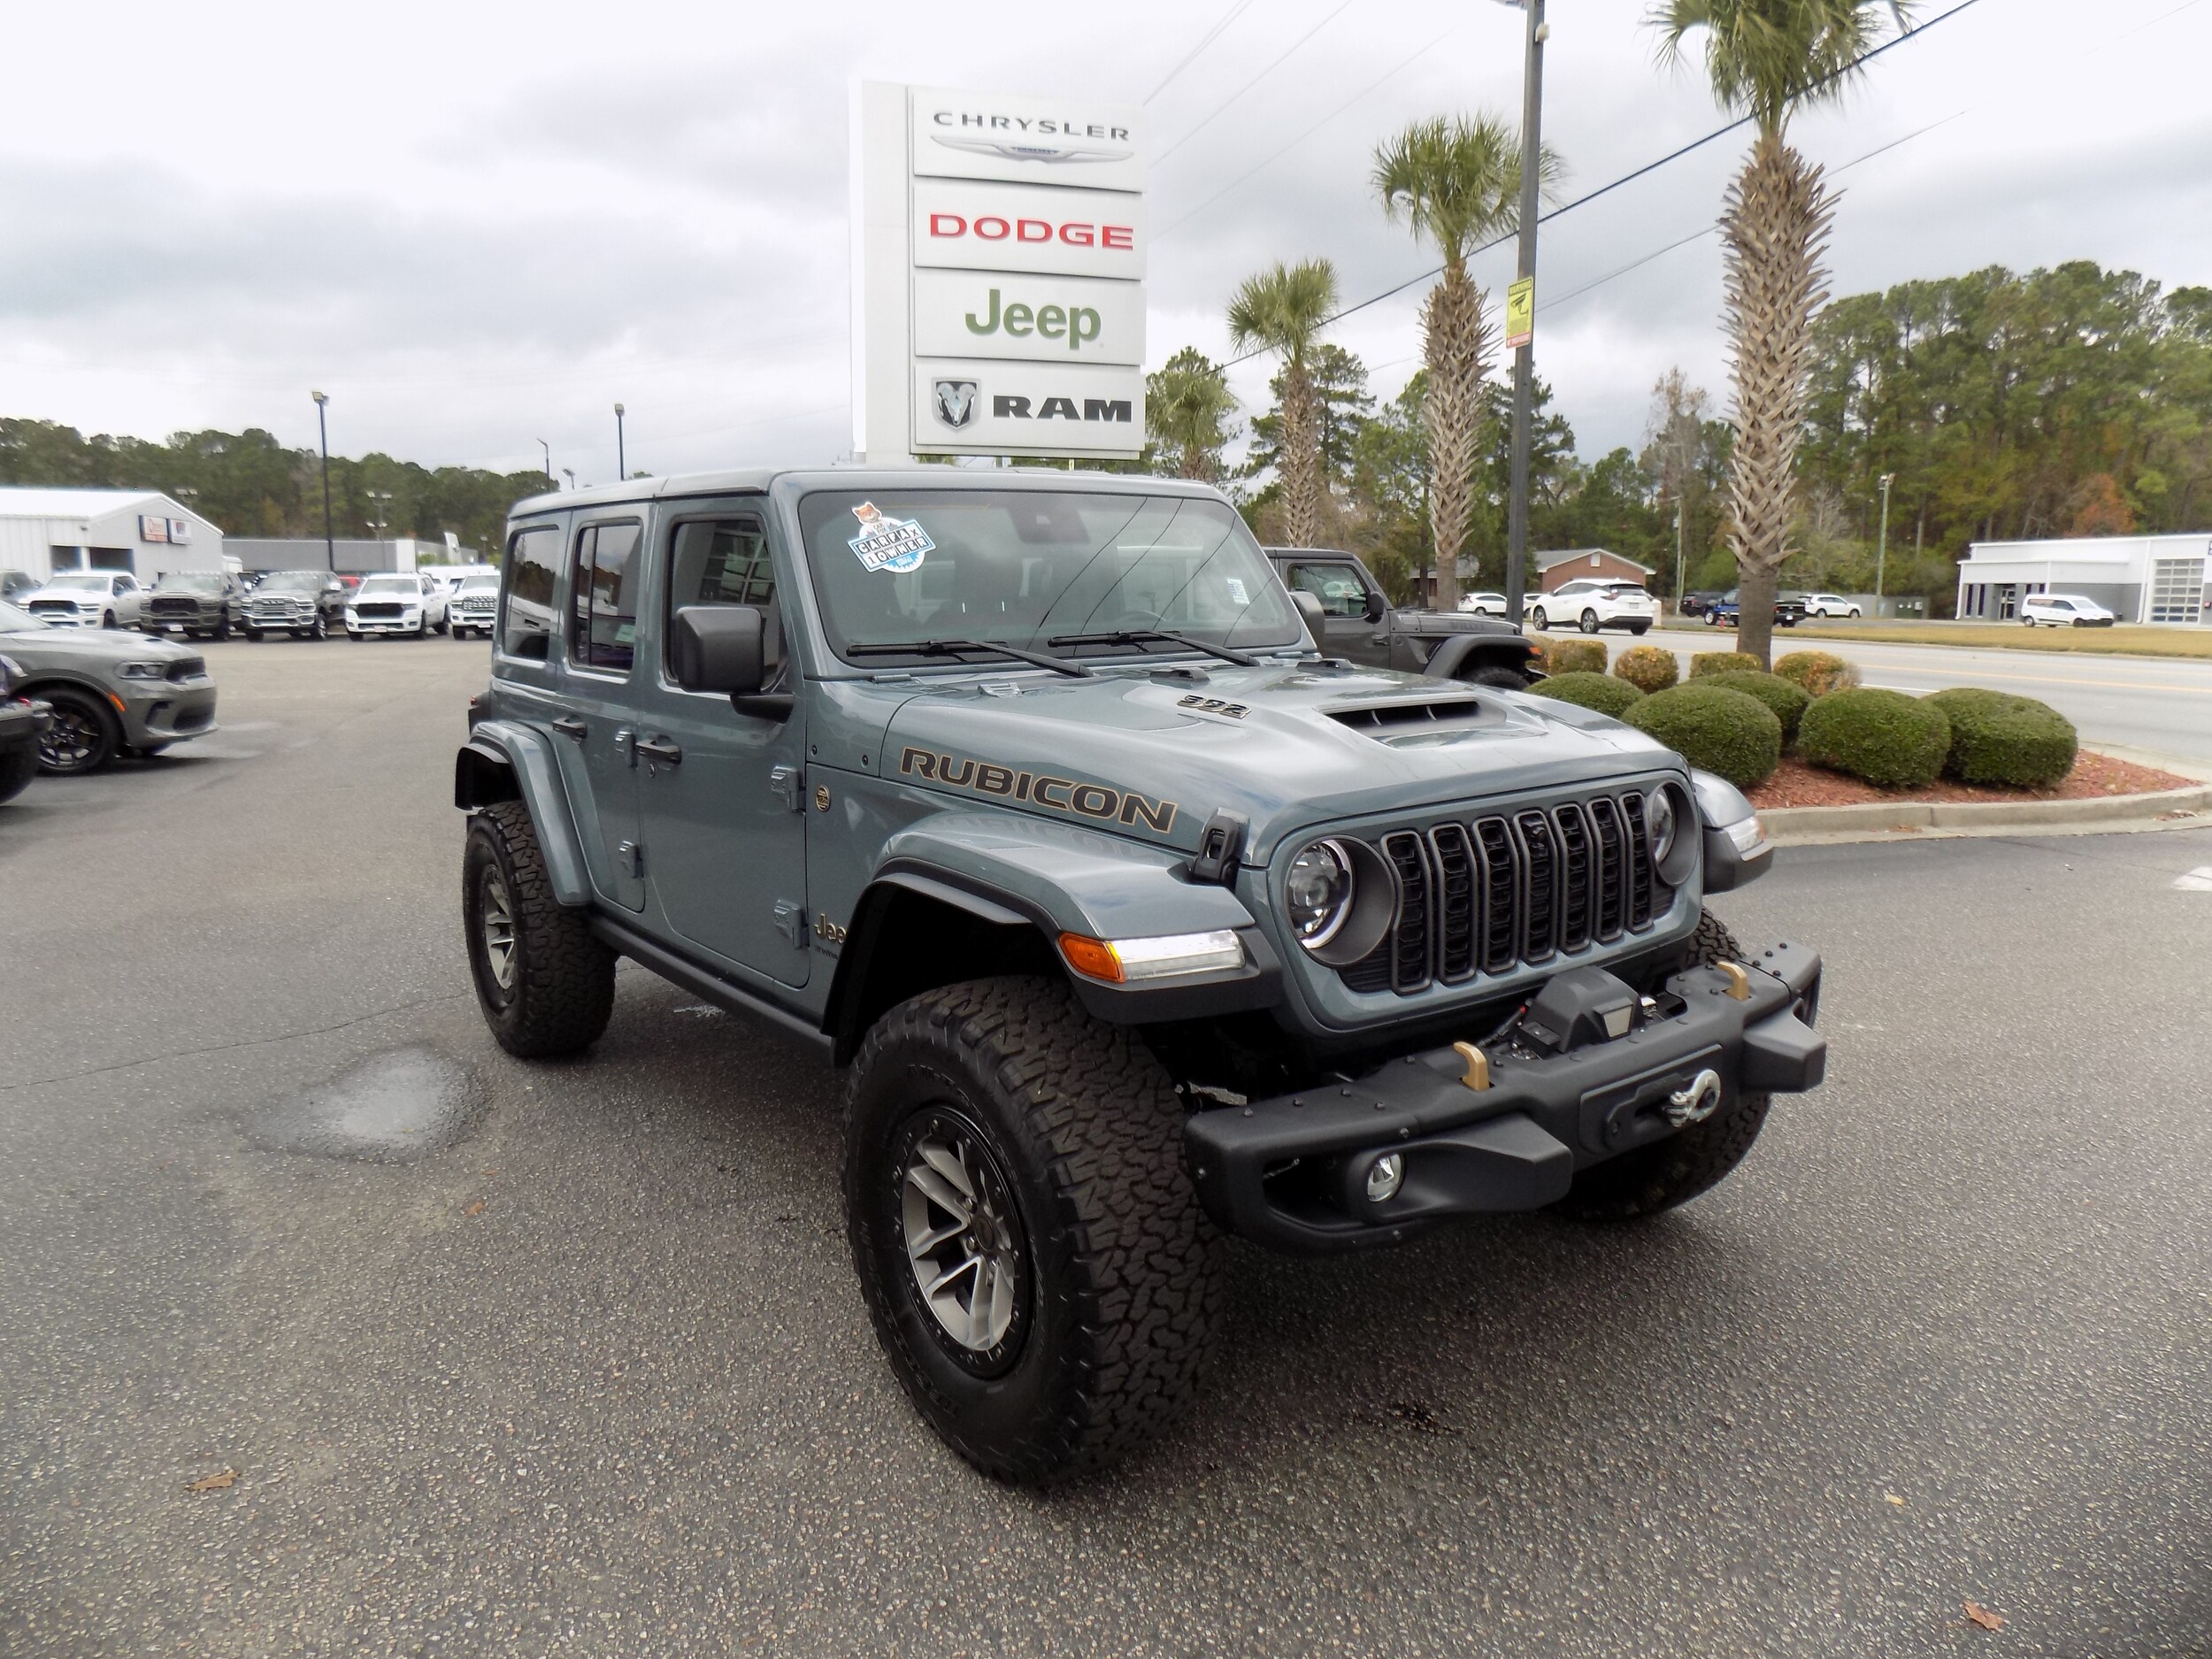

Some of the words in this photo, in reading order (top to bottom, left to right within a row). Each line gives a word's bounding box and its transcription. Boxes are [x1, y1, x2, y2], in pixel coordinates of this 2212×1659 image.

[933, 111, 1130, 141] CHRYSLER
[930, 213, 1134, 251] DODGE
[964, 288, 1102, 350] Jeep
[993, 395, 1133, 423] RAM
[857, 528, 919, 553] CARFAX
[867, 555, 877, 565] 1
[877, 537, 928, 562] OWNER
[1177, 695, 1252, 719] 392
[900, 747, 1179, 834] RUBICON
[813, 913, 847, 944] Jee
